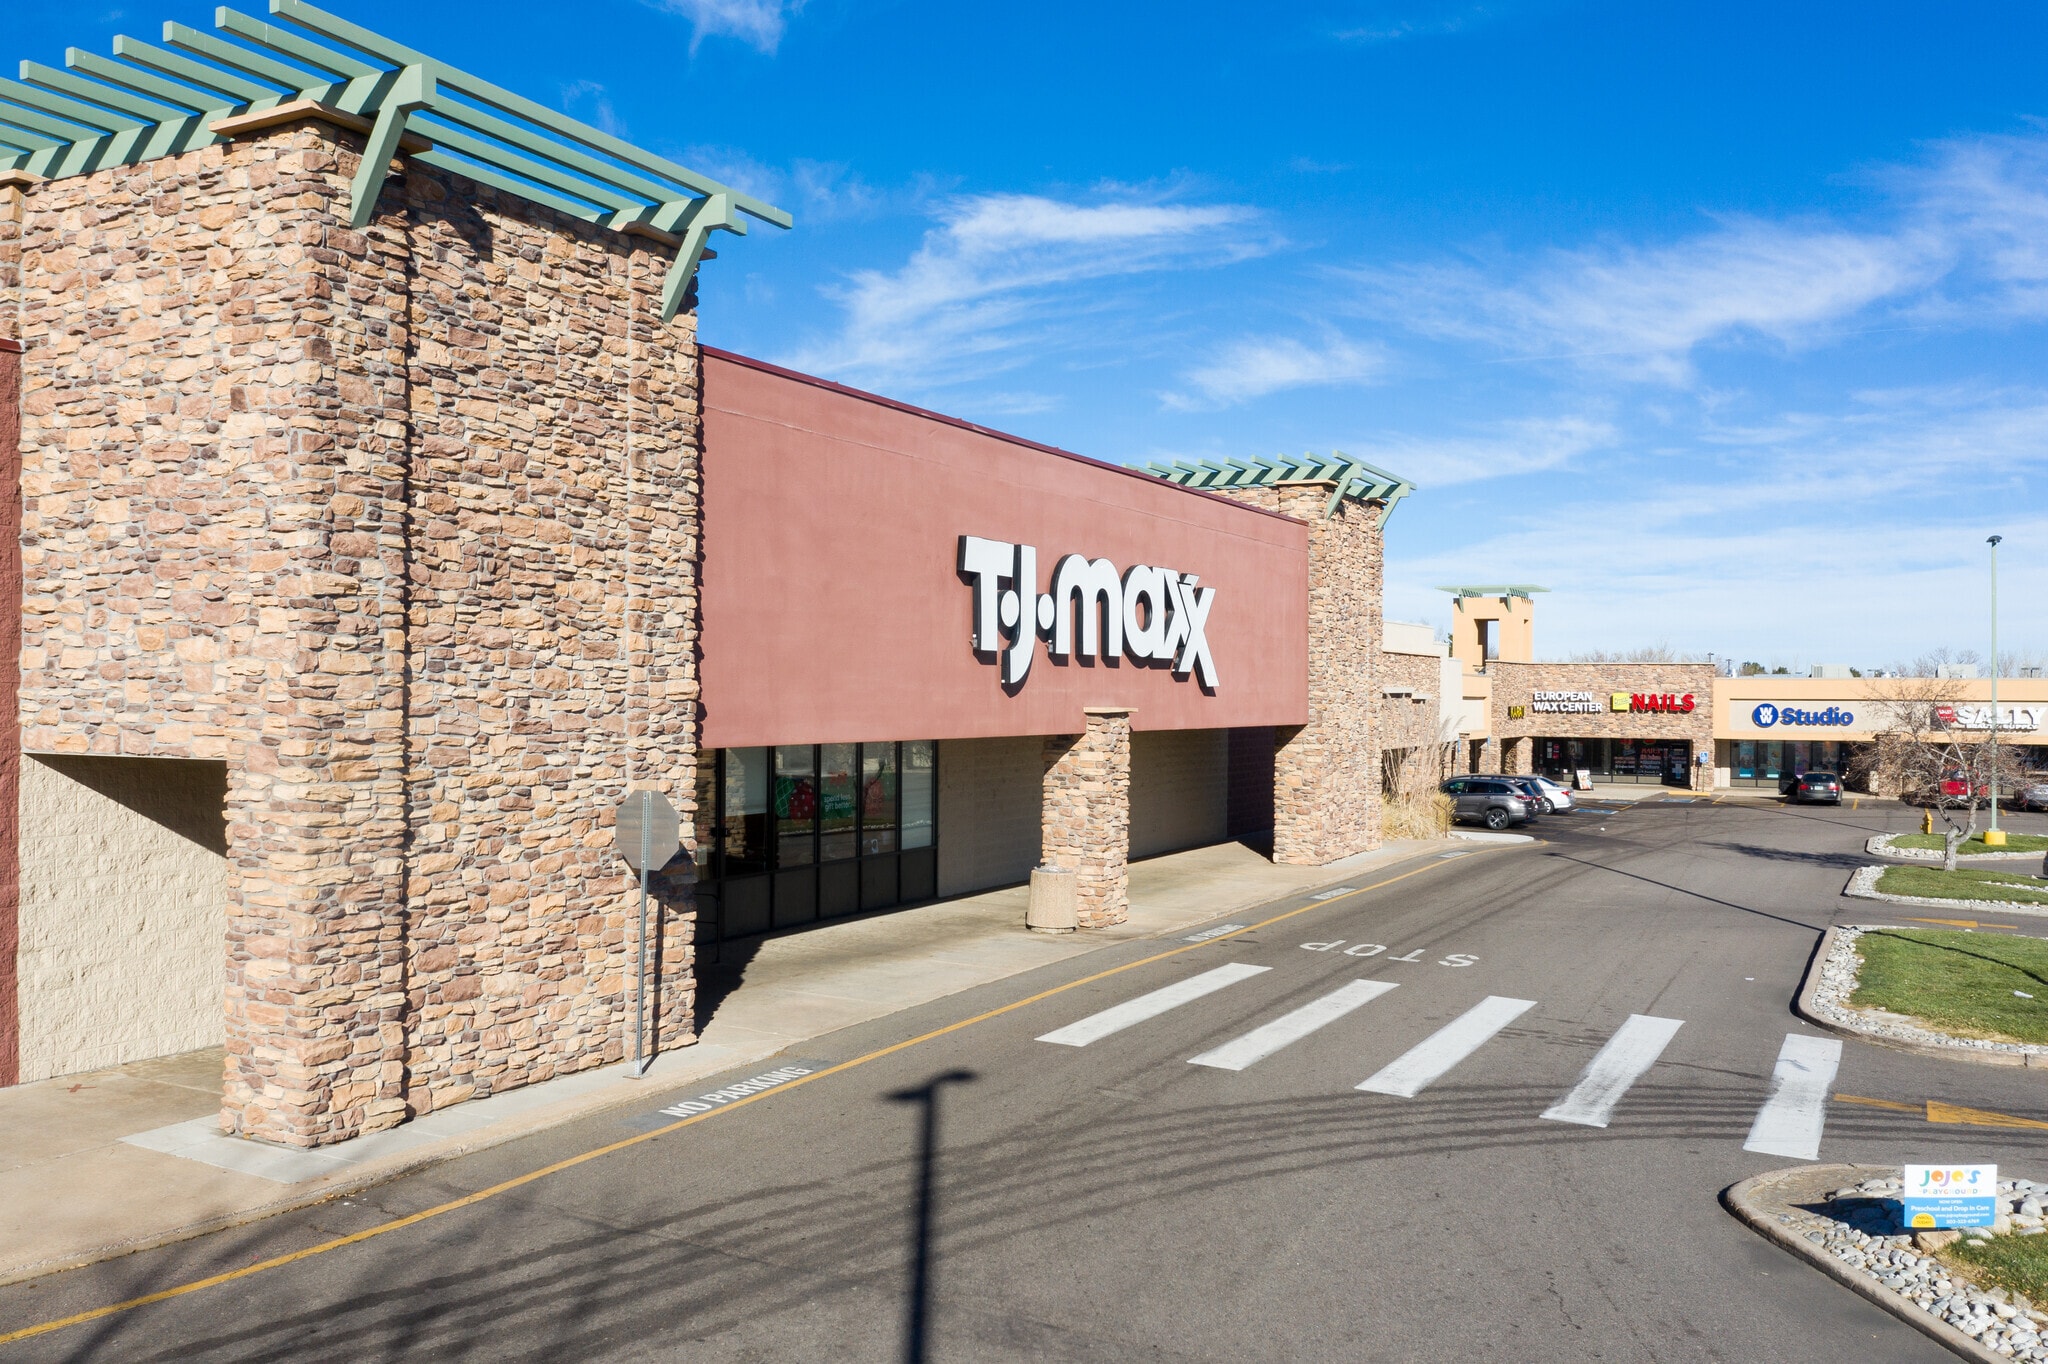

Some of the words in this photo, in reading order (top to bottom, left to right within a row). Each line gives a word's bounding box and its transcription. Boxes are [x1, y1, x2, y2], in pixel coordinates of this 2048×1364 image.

[1533, 691, 1592, 701] EUROPEAN
[1632, 693, 1695, 711] NAILS
[1533, 702, 1558, 713] WAX
[1560, 702, 1602, 712] CENTER
[1780, 706, 1854, 726] Studio
[1957, 706, 2047, 725] SALLY
[1300, 939, 1480, 967] STOP
[658, 1101, 712, 1118] NO
[699, 1066, 814, 1103] PARKING
